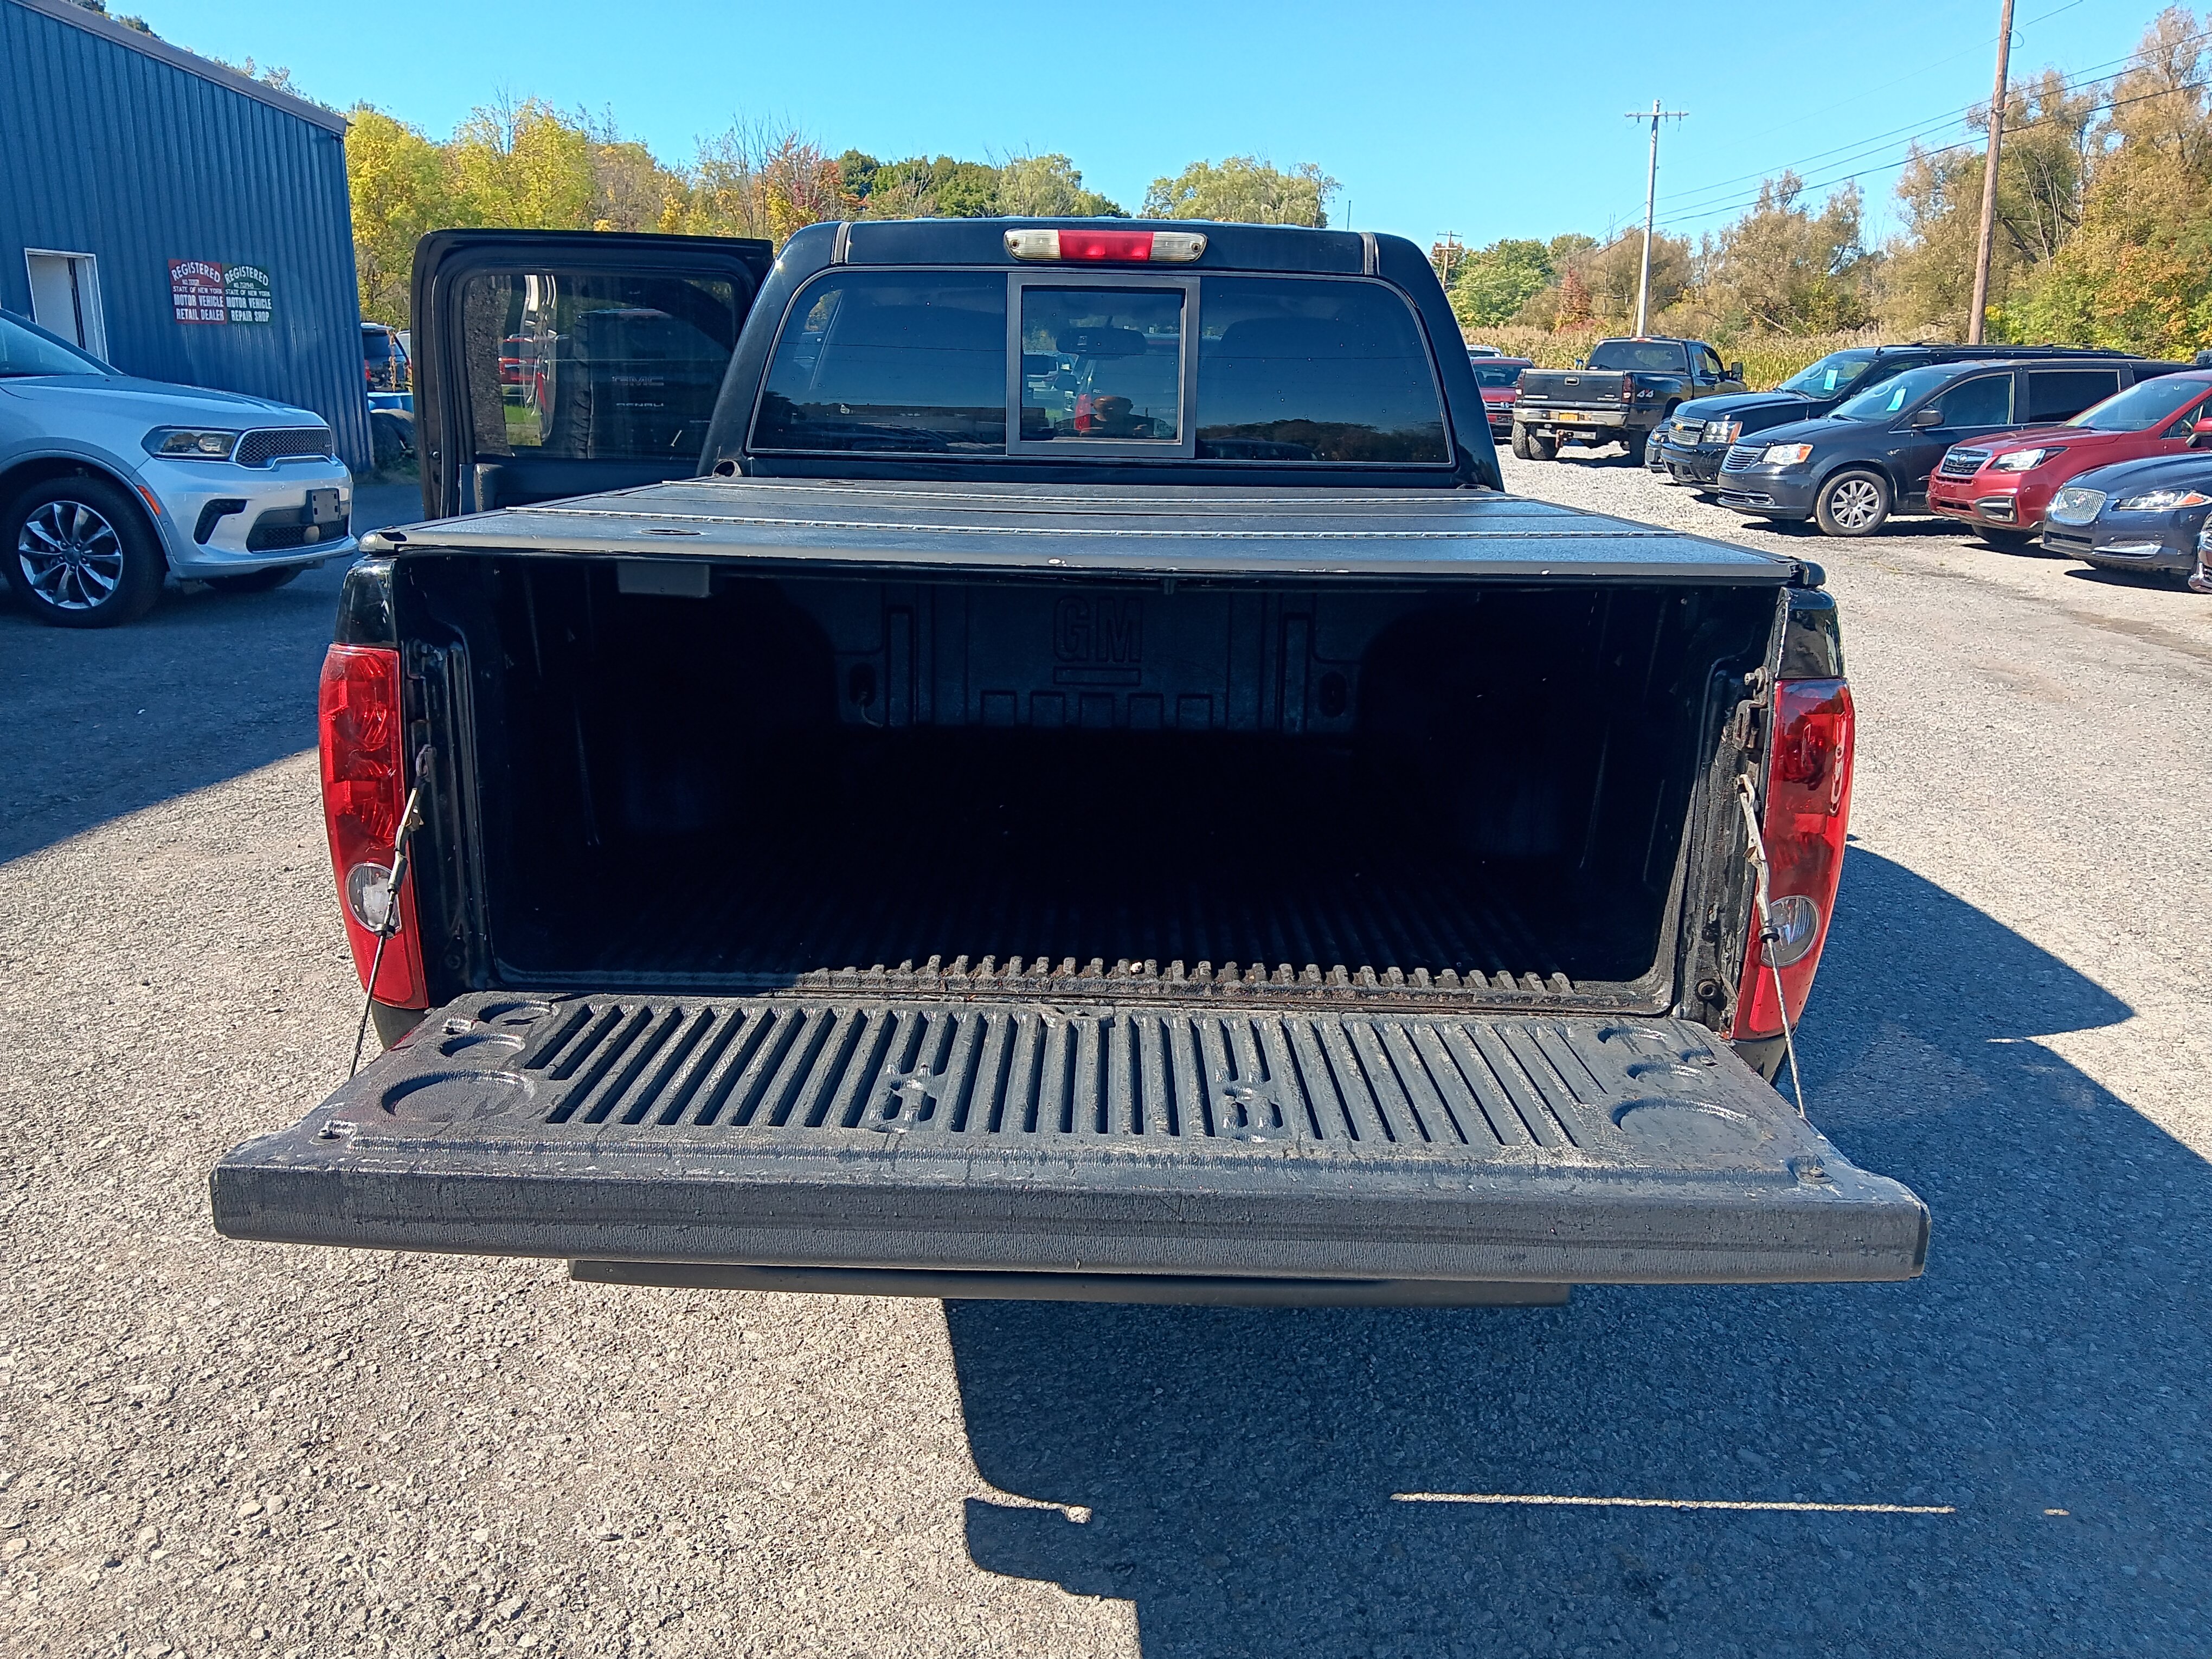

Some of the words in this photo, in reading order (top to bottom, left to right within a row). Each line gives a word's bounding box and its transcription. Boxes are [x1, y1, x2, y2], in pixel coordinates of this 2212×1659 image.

[171, 262, 221, 282] REGISTERED
[224, 265, 269, 286] REGISTERED
[173, 293, 197, 306] MOTOR
[198, 294, 224, 307] VEHICLE
[226, 296, 247, 308] MOTOR
[248, 297, 272, 310] VEHICLE
[176, 307, 199, 320] RETAIL
[200, 308, 224, 321] DEALER
[230, 310, 253, 321] REPAIR
[254, 311, 269, 322] SHOP
[614, 376, 664, 386] GMC
[1053, 594, 1143, 663] GM
